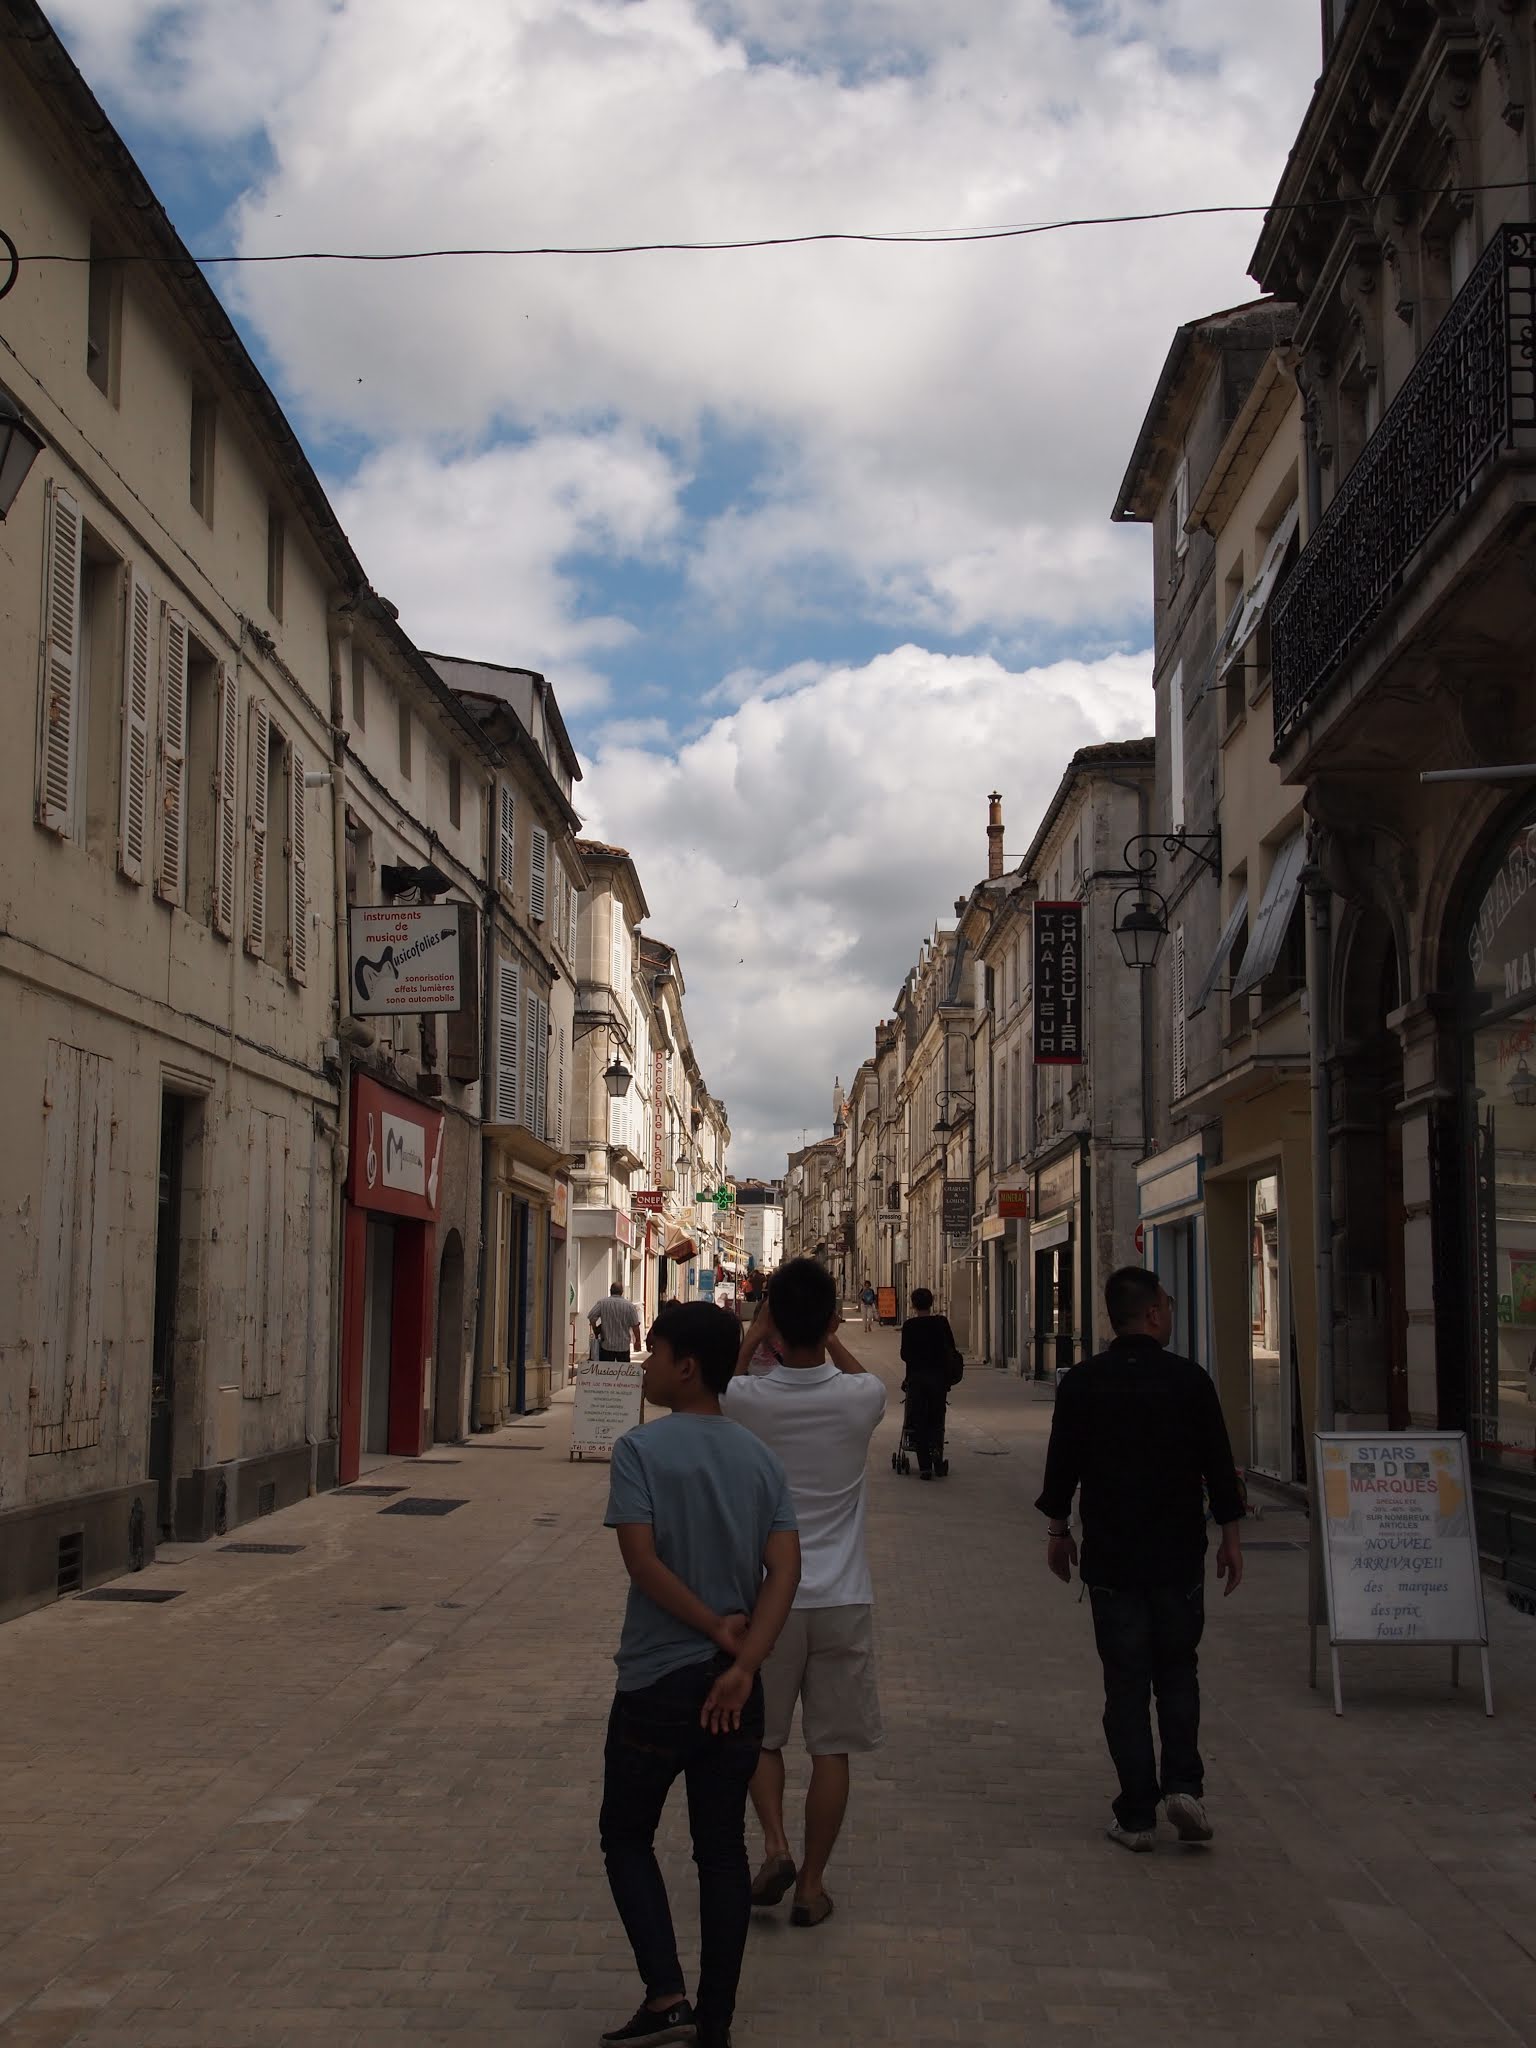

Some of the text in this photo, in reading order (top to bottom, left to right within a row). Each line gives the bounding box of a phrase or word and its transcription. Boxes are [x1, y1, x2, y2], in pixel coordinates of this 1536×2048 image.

[364, 912, 421, 921] instruments
[395, 922, 408, 931] de
[366, 933, 409, 943] musique
[355, 933, 440, 1001] Musicofolies
[1505, 947, 1536, 1000] MA
[405, 973, 454, 982] sonorisation
[1040, 914, 1055, 1052] TRAITEUR
[1061, 915, 1077, 1052] CHARCUTIER
[395, 984, 455, 993] effets lumières
[409, 994, 455, 1003] automobile
[654, 1131, 662, 1185] blanche
[581, 1363, 640, 1380] Musicofolies
[1358, 1447, 1416, 1460] STARS
[1384, 1462, 1397, 1476] D
[1350, 1480, 1438, 1493] MARQUES
[1365, 1537, 1433, 1550] NOUVEL
[1364, 1580, 1449, 1596] des marques
[1371, 1603, 1422, 1620] des prix
[1376, 1623, 1403, 1638] fous
